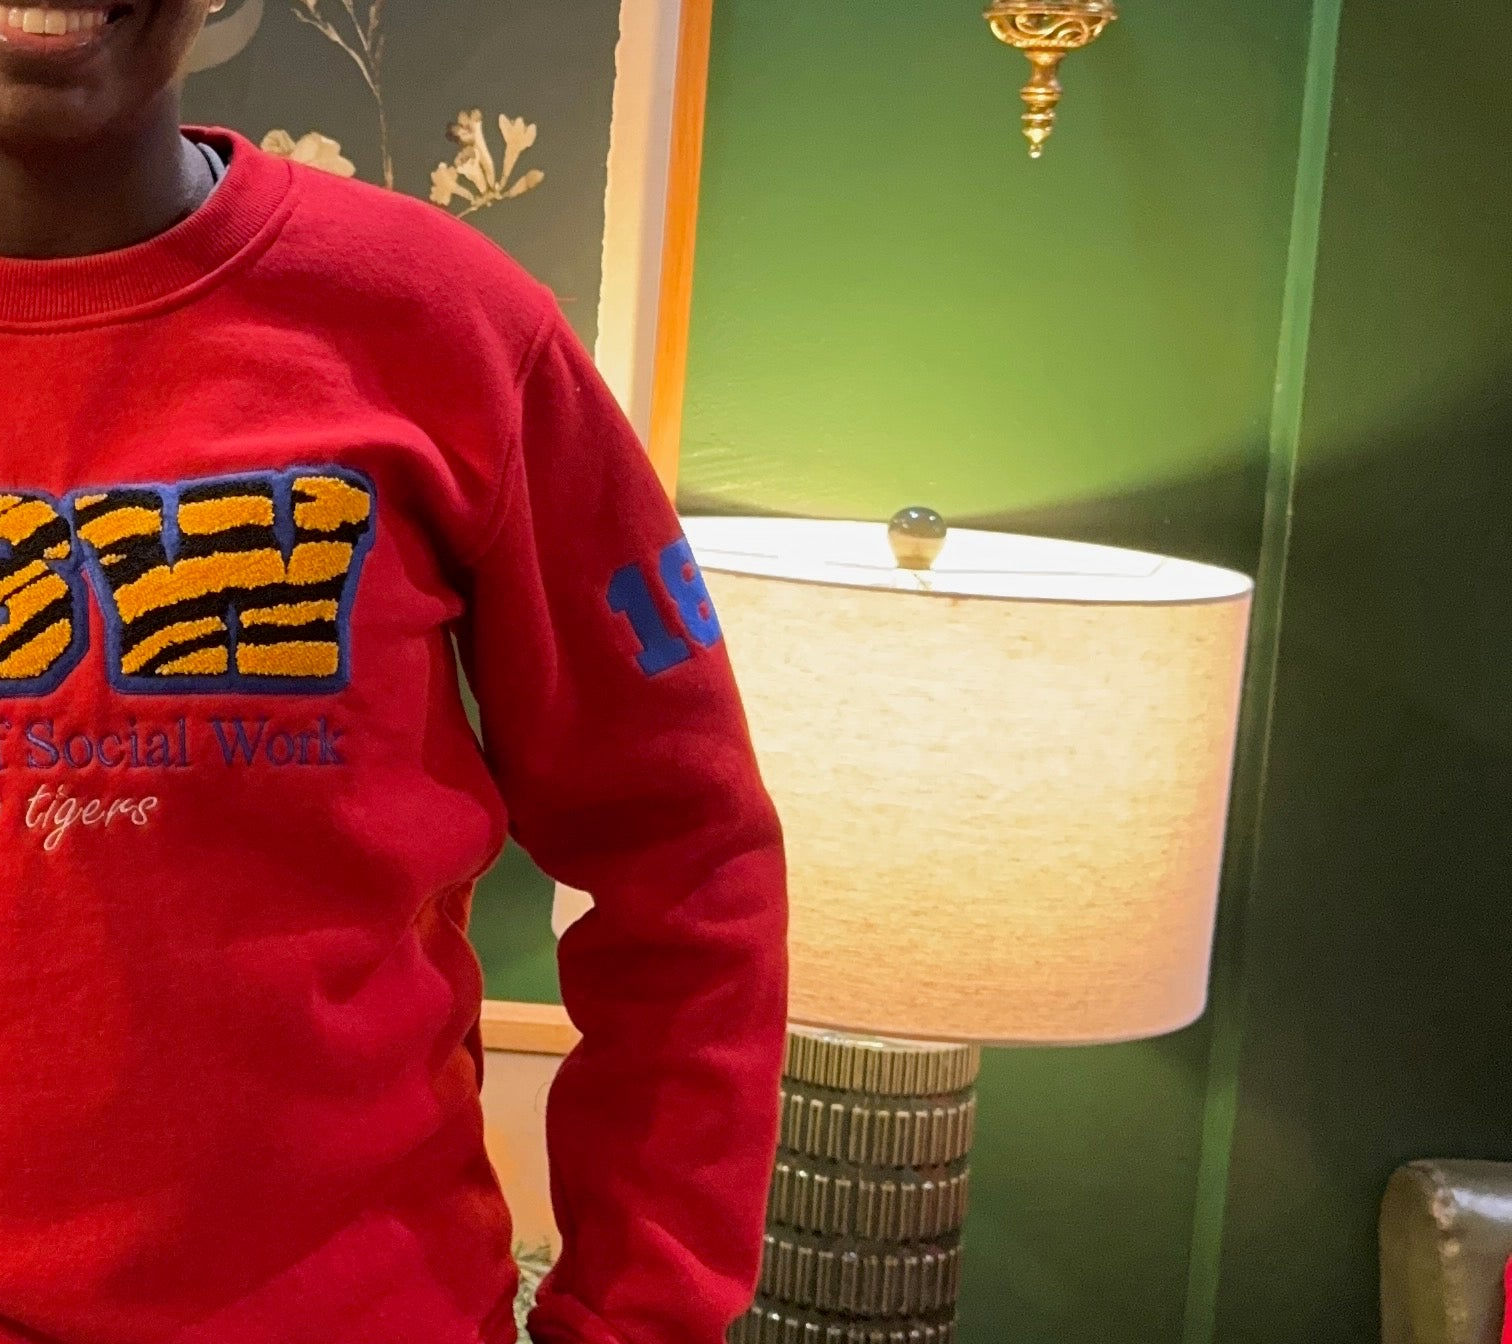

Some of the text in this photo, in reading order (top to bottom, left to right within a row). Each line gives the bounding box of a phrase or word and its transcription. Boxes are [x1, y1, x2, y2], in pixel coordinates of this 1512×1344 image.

[24, 718, 191, 771] Social
[210, 713, 347, 768] Work
[25, 783, 158, 851] tigers
